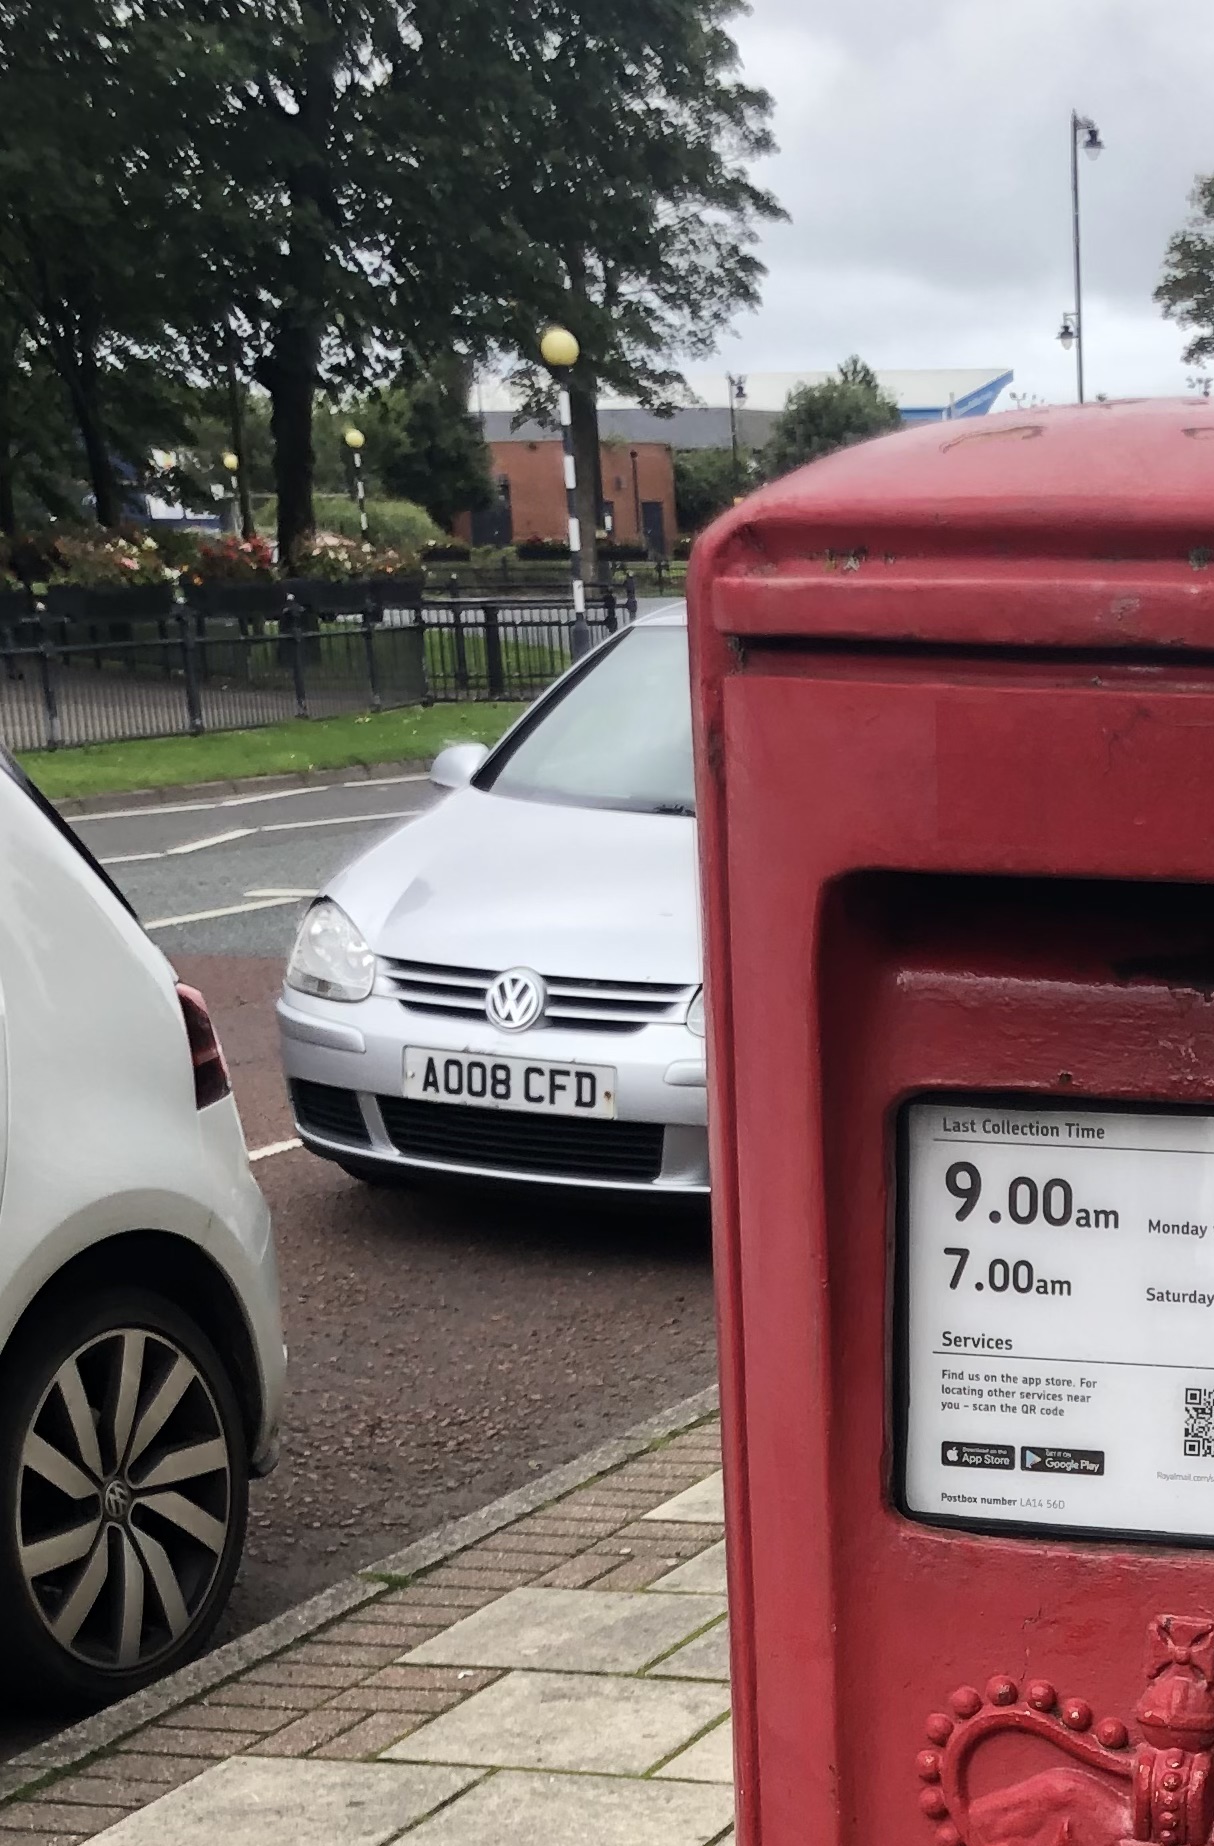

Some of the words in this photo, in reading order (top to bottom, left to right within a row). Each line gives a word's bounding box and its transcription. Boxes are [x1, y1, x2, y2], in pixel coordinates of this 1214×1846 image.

[524, 1067, 596, 1108] CFD
[943, 1118, 976, 1133] Last
[982, 1118, 1059, 1137] Collection
[1065, 1123, 1105, 1139] Time
[945, 1161, 1119, 1229] 9.00am
[1148, 1219, 1207, 1239] Monday
[944, 1248, 1072, 1296] 7.00am
[1146, 1287, 1214, 1307] Saturday
[942, 1331, 1012, 1350] Services
[942, 1370, 964, 1381] Find
[968, 1373, 980, 1381] us
[984, 1374, 996, 1383] on
[1001, 1374, 1018, 1384] the
[1022, 1376, 1041, 1387] app
[1045, 1377, 1075, 1387] store.
[1080, 1378, 1097, 1388] For
[942, 1384, 983, 1398] locating
[988, 1388, 1016, 1399] other
[1020, 1390, 1063, 1401] services
[1067, 1394, 1091, 1402] near
[941, 1401, 959, 1411] you
[973, 1402, 996, 1412] scan
[1000, 1403, 1017, 1413] the
[1021, 1404, 1036, 1415] QR
[1040, 1406, 1064, 1417] code
[962, 1453, 982, 1465] App
[984, 1454, 1010, 1465] Store
[1045, 1458, 1079, 1471] Google
[1080, 1460, 1099, 1472] Play
[941, 1493, 977, 1503] Postbox
[981, 1497, 1017, 1506] number
[1020, 1498, 1043, 1508] LA14
